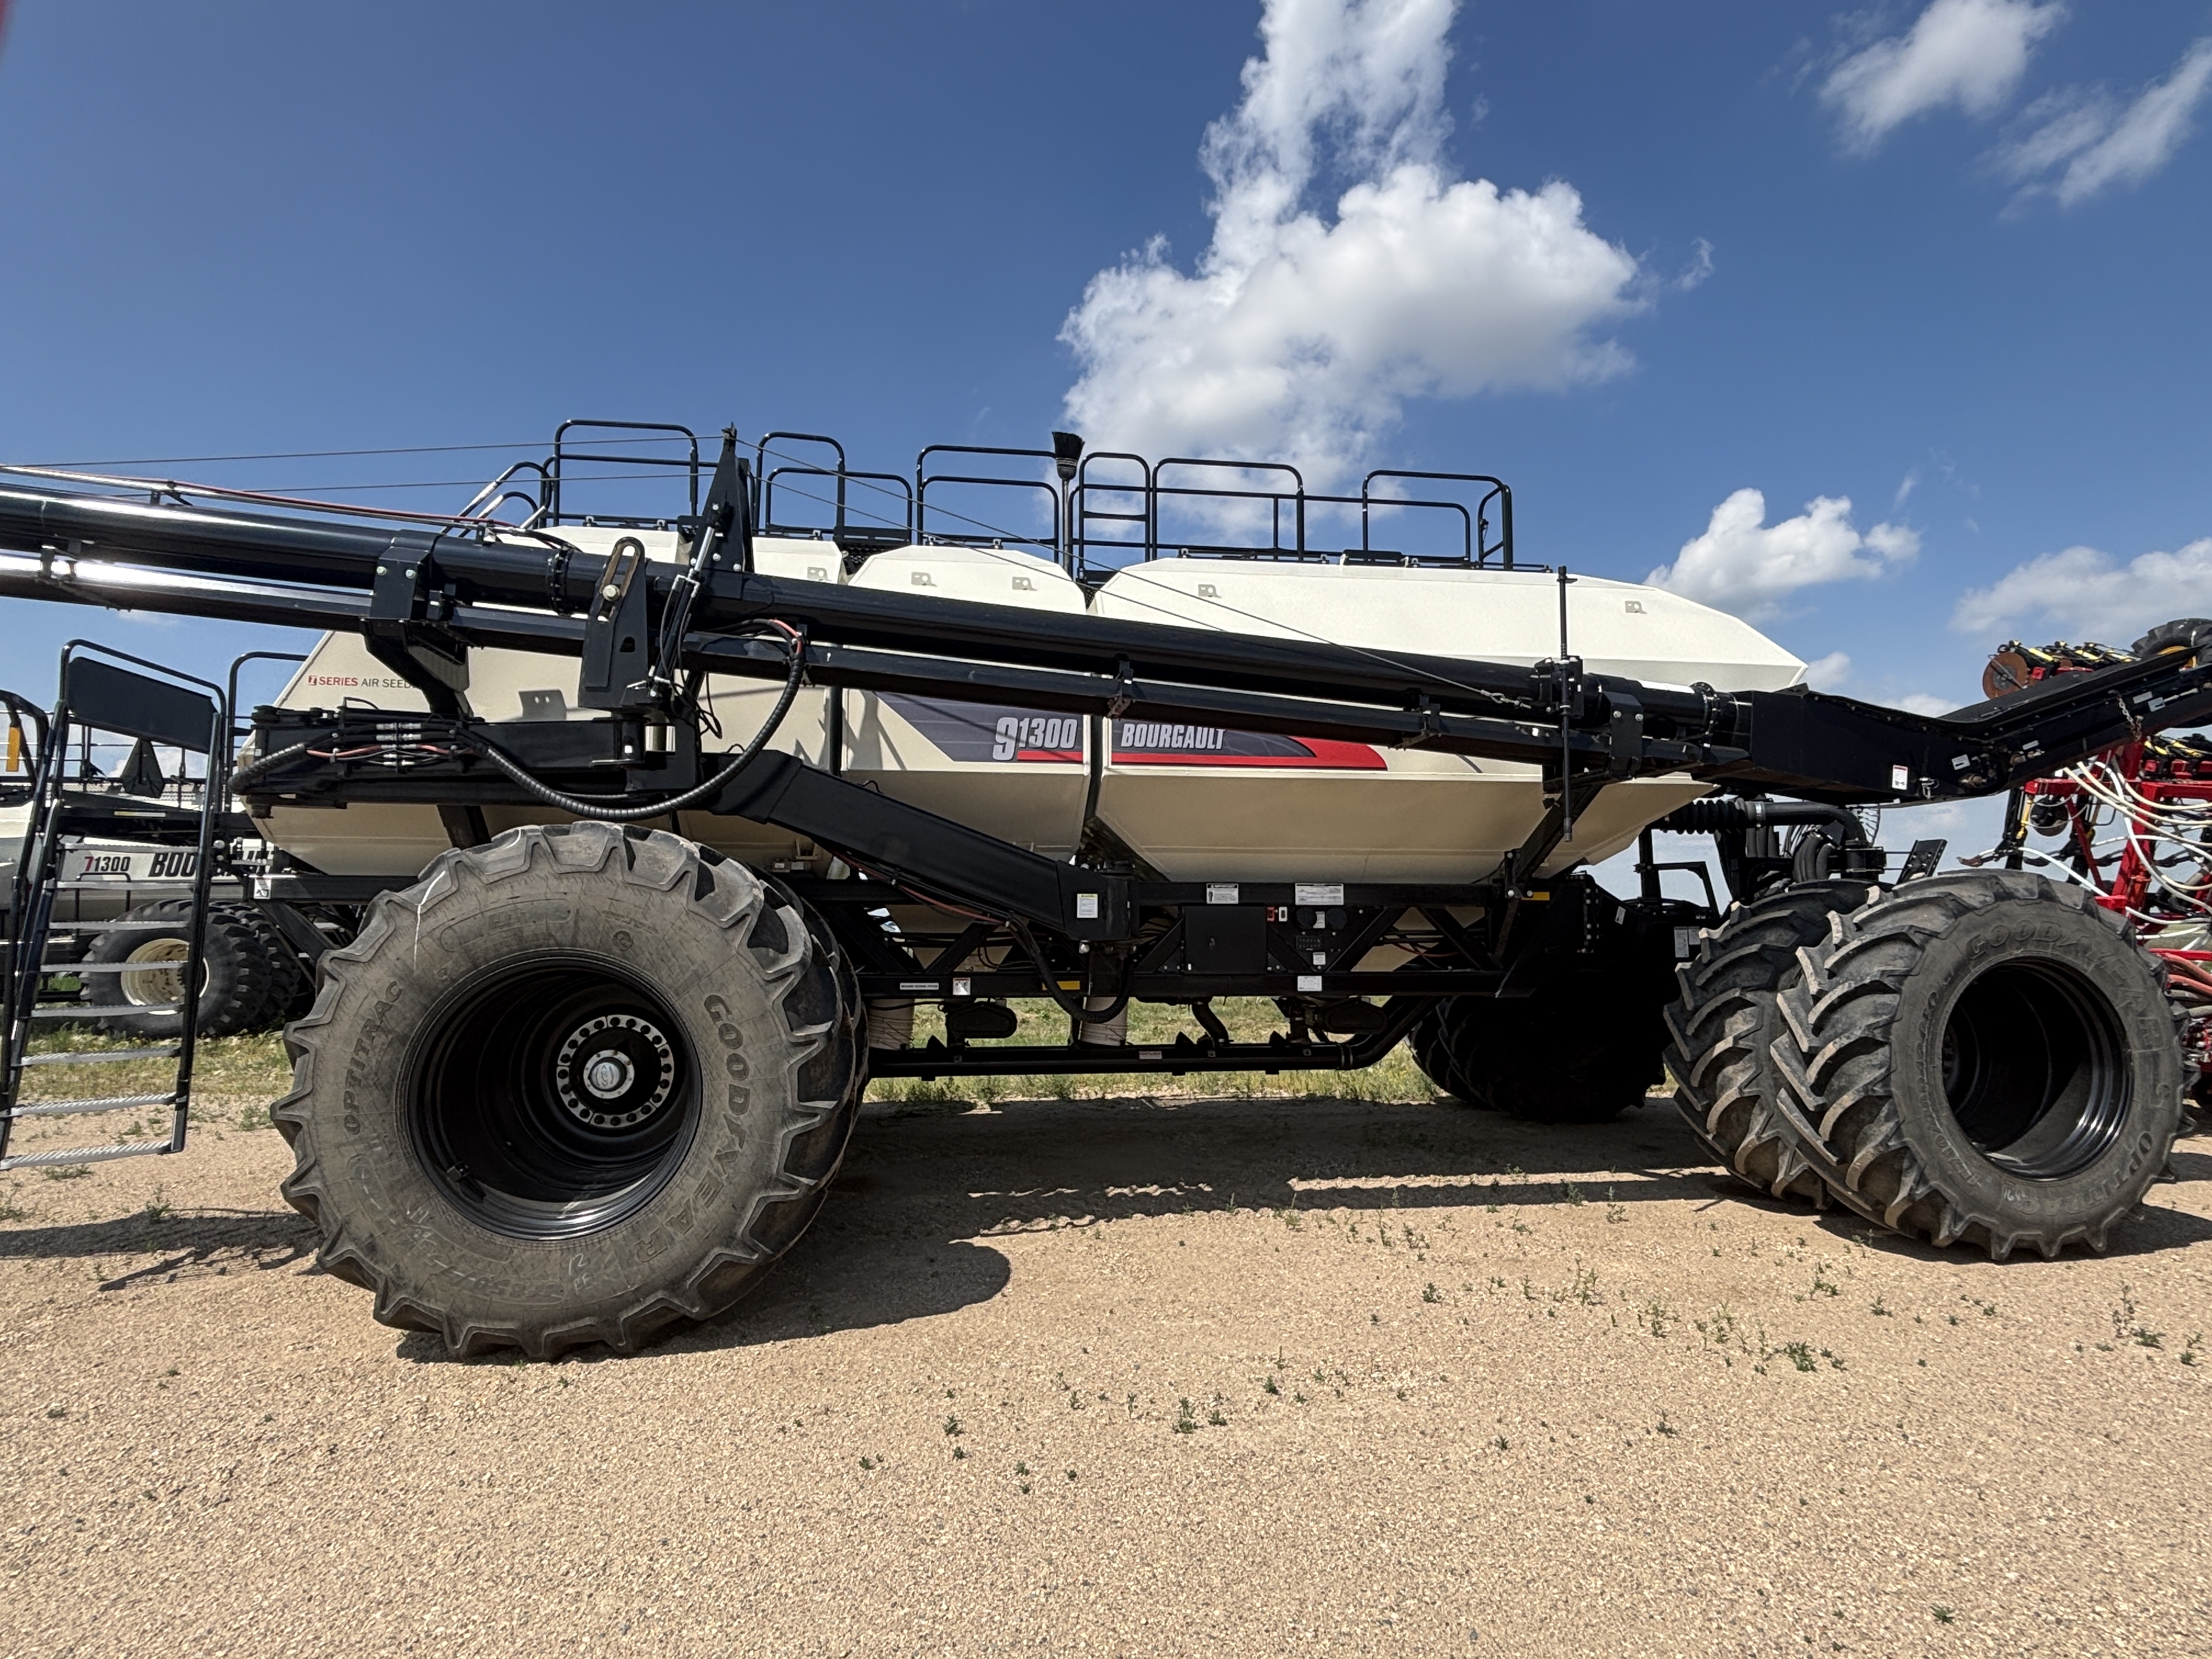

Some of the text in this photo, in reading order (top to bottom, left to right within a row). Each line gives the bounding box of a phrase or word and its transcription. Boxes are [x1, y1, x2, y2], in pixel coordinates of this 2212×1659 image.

[319, 676, 358, 686] SERIES
[361, 678, 380, 687] AIR
[382, 679, 412, 689] SEED
[992, 717, 1077, 761] 91300
[1121, 724, 1226, 750] BOURGAULT
[84, 856, 132, 872] 71300
[1967, 919, 2165, 1047] GOODYEAR
[343, 981, 403, 1135] OPTITRAC
[635, 994, 751, 1262] GOODYEAR
[2019, 1132, 2152, 1214] OPTITRAC
